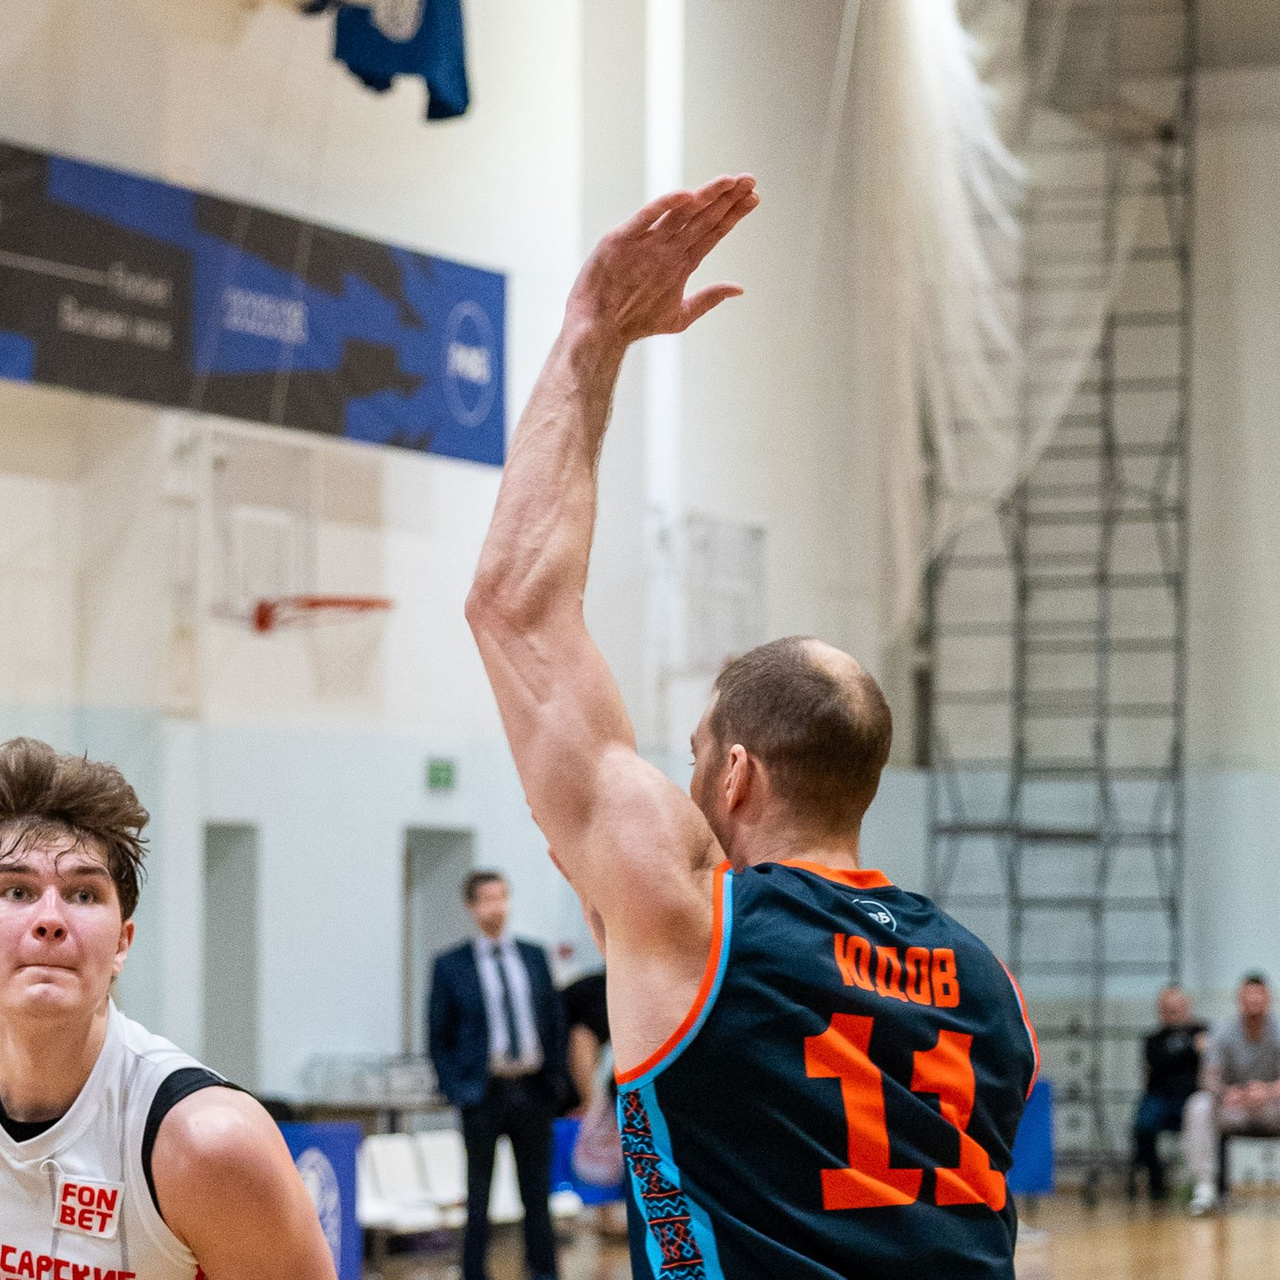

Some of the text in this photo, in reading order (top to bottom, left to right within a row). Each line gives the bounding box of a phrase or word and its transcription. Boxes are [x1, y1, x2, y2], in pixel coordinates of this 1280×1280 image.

[804, 1012, 1007, 1212] 11
[61, 1183, 118, 1212] FON
[59, 1203, 113, 1233] BET
